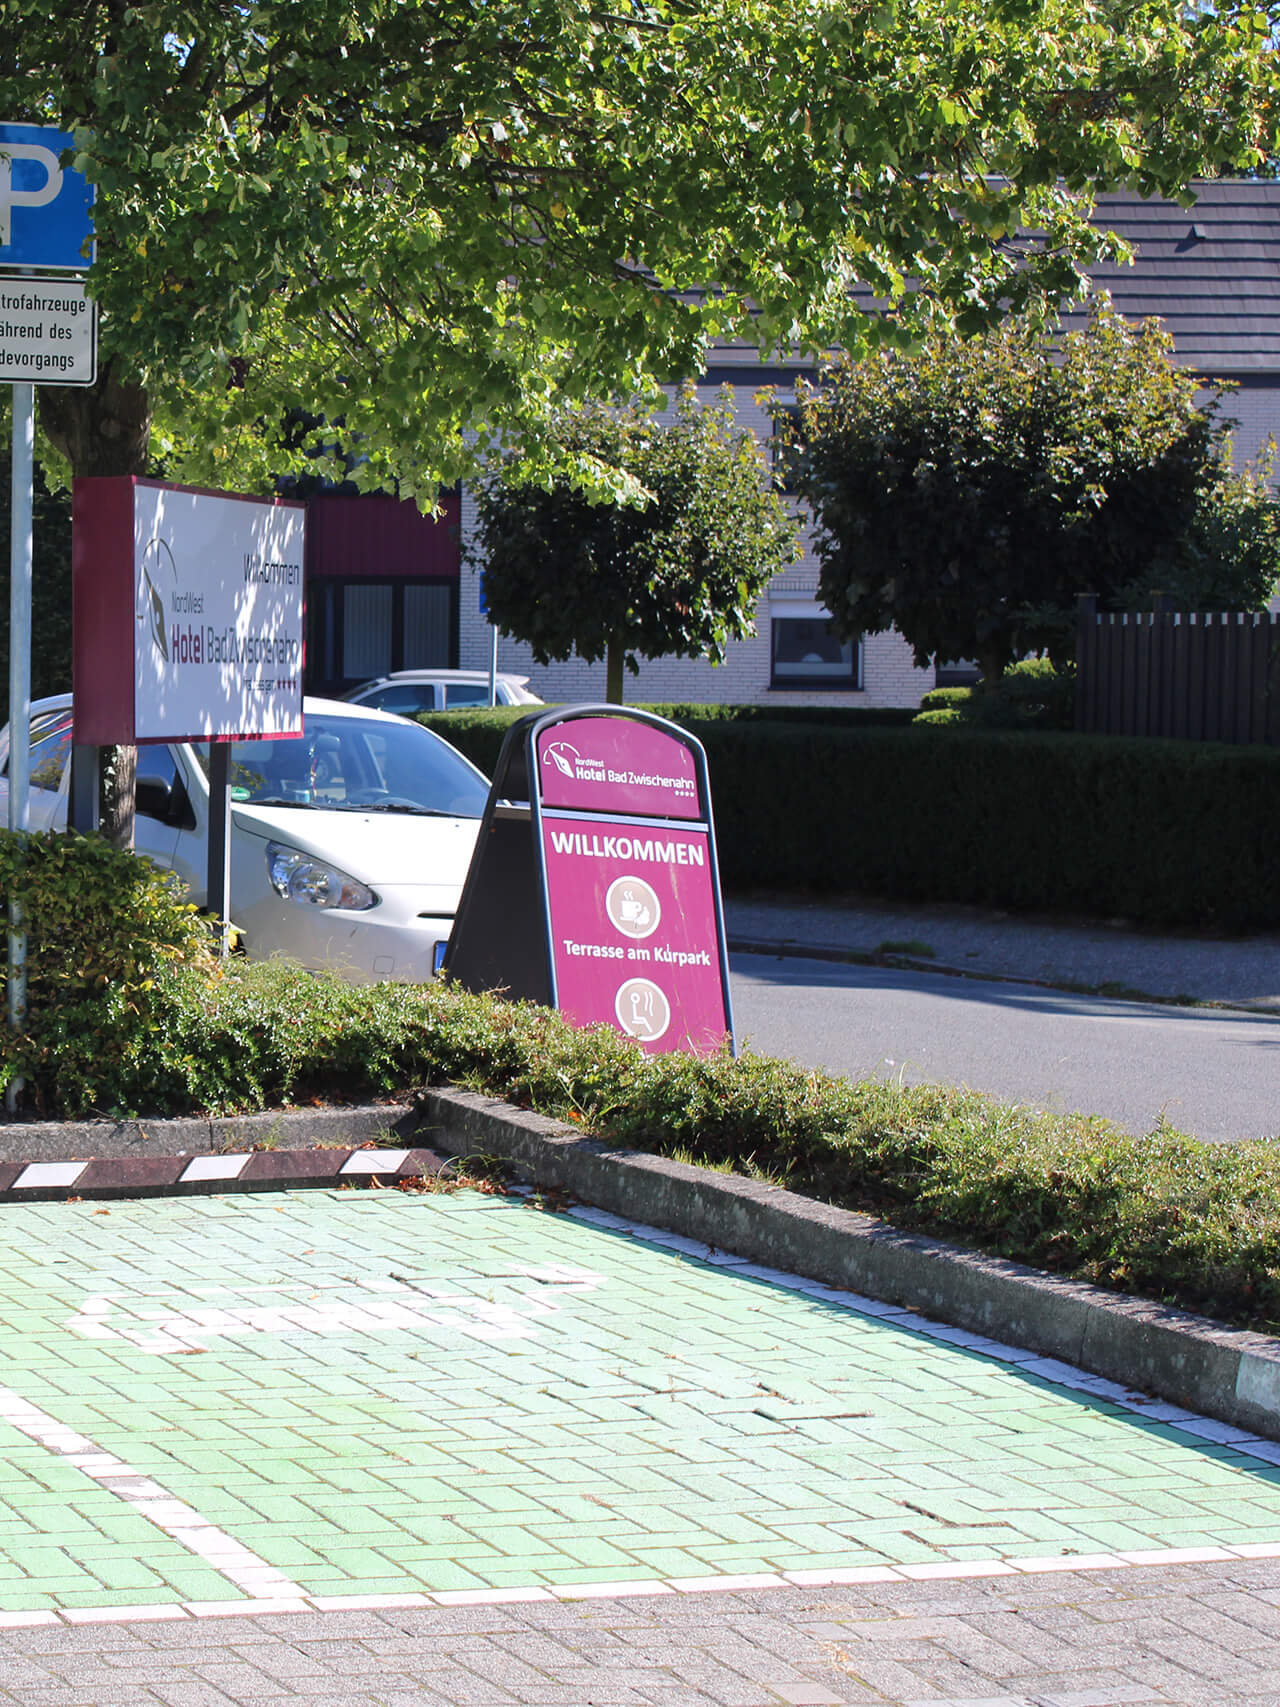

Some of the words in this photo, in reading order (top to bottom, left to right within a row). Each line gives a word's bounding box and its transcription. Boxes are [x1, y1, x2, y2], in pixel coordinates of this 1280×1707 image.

[49, 323, 73, 340] des
[171, 623, 205, 665] Hotel
[207, 626, 228, 664] Bad
[575, 758, 605, 768] NordWest
[575, 767, 606, 782] Hotel
[607, 769, 627, 783] Bad
[628, 771, 695, 790] Zwischenahn
[551, 831, 705, 866] WILLKOMMEN
[563, 939, 624, 960] Terrasse
[627, 948, 651, 962] am
[653, 949, 711, 968] Kurpark
